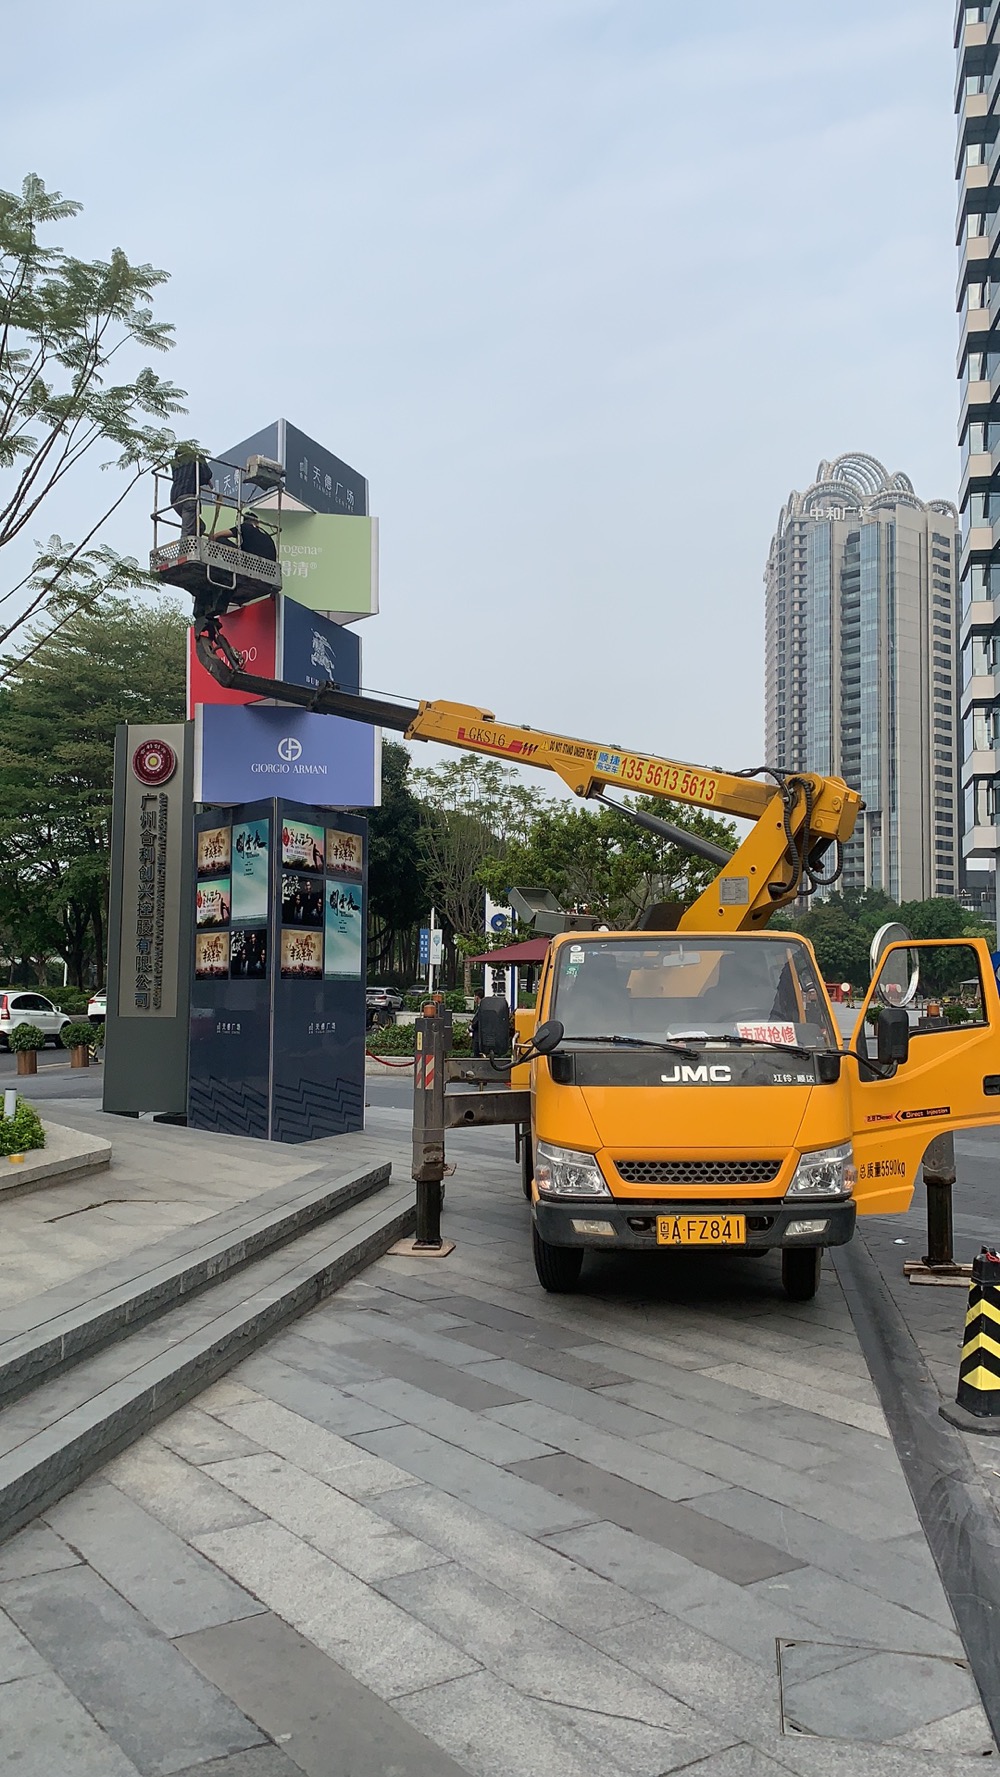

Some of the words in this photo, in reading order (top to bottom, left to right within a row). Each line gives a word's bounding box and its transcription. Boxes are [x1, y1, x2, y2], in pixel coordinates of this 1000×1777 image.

[312, 465, 355, 507] 天德广场
[468, 726, 506, 747] GKS16
[251, 763, 290, 774] GIORGIO
[292, 764, 328, 775] ARMANI
[621, 757, 644, 781] 135
[645, 763, 679, 791] 5613
[681, 773, 716, 801] 5613
[134, 792, 158, 1010] 广州合利创兴控股有限公司
[740, 1026, 795, 1044] 市政抢修
[660, 1065, 732, 1082] JMC
